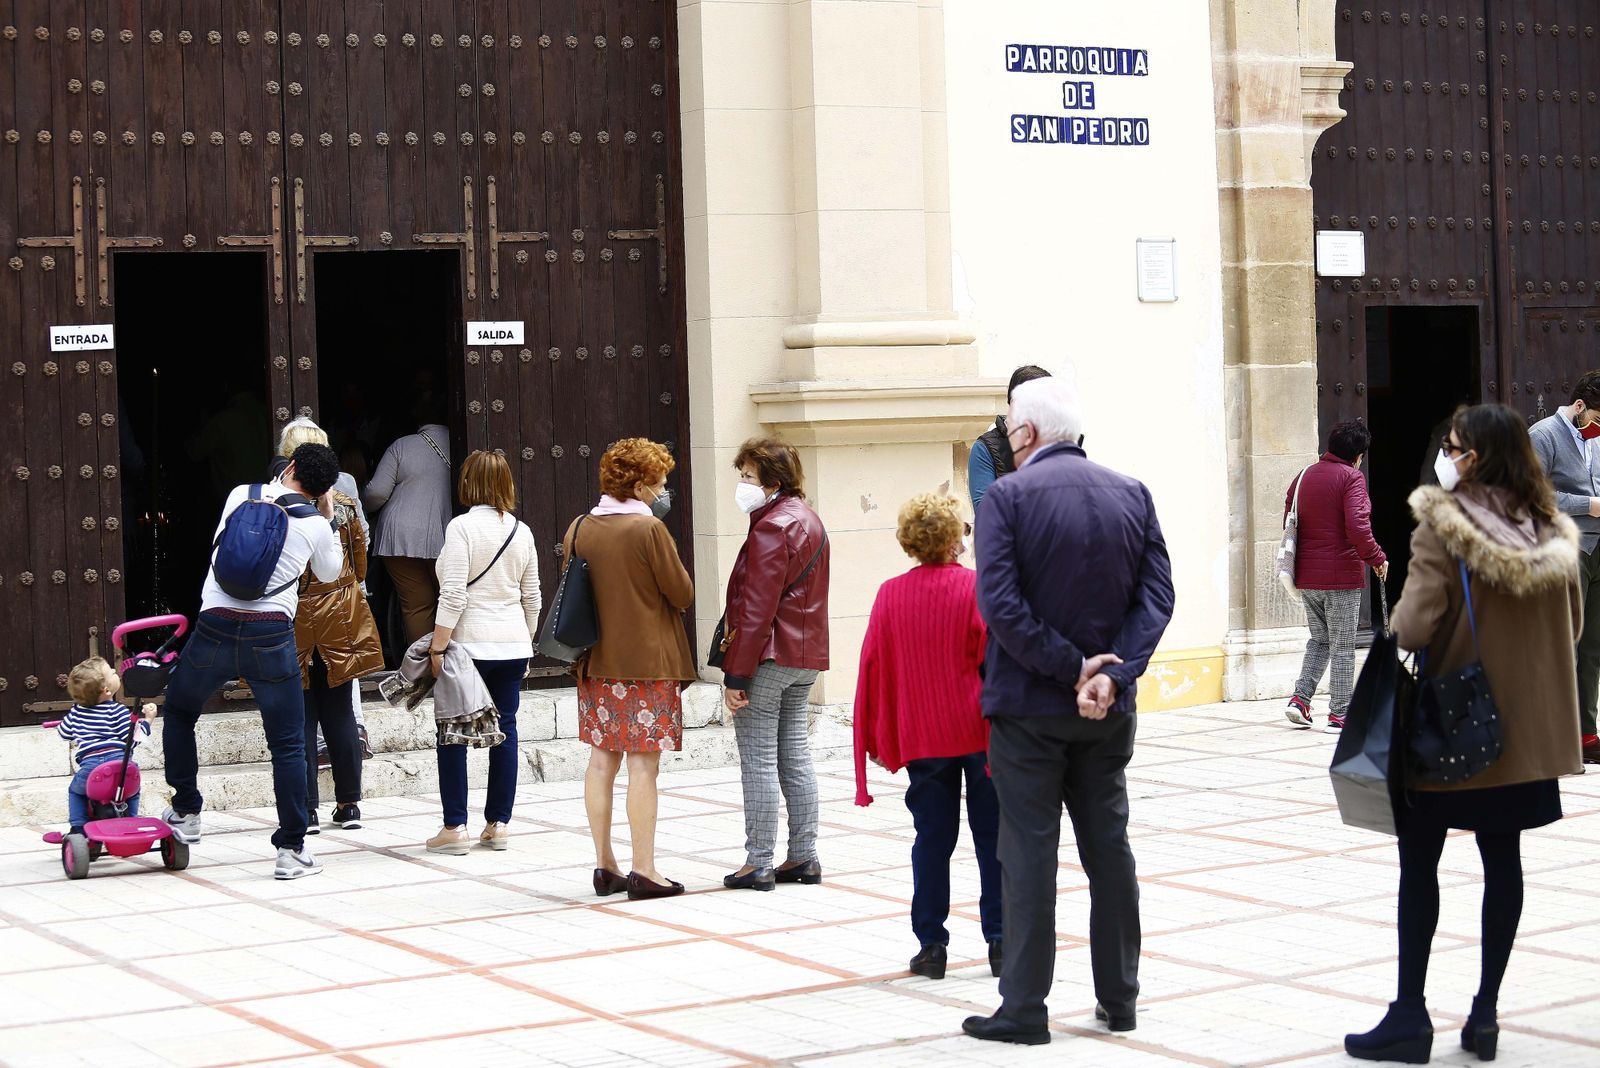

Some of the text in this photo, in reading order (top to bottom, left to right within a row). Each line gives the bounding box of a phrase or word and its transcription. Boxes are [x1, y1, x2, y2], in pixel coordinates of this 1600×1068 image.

[1006, 46, 1148, 74] PARROQUIA
[1064, 83, 1093, 107] DE
[1013, 117, 1148, 143] SAN PEDRO
[54, 334, 109, 345] ENTRADA
[477, 330, 514, 340] SALIDA
